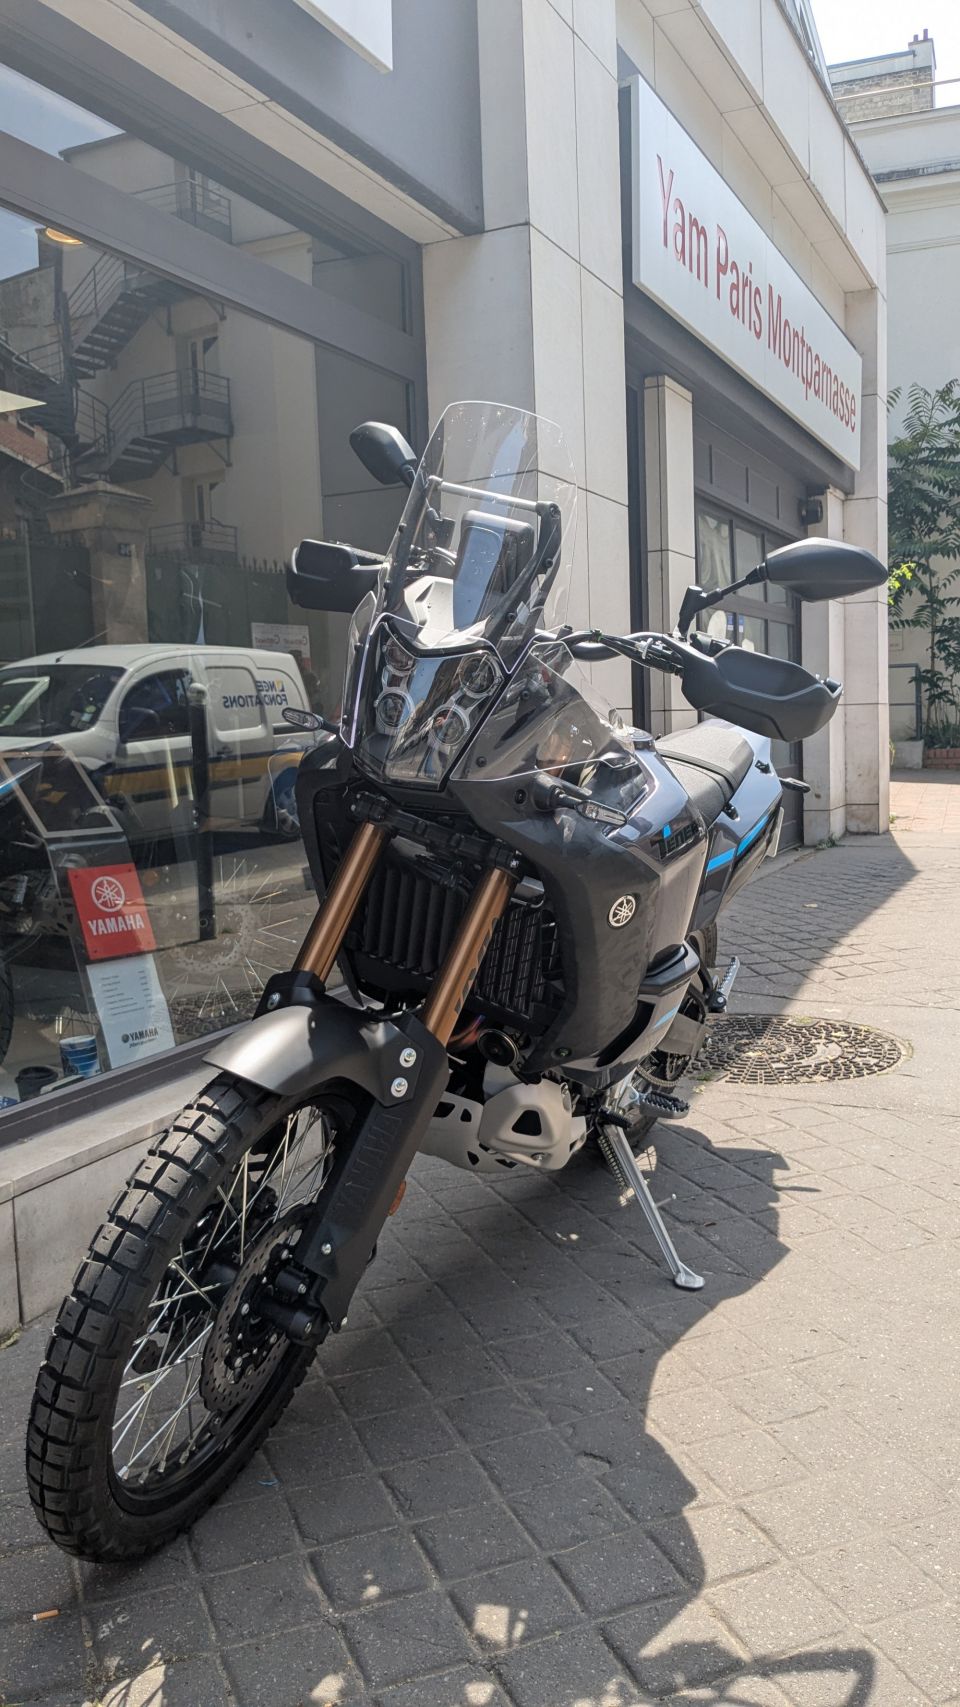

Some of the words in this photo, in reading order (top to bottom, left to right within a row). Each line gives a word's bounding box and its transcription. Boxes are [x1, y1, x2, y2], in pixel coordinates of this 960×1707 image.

[656, 153, 708, 288] Yam
[716, 223, 762, 340] Paris
[767, 283, 856, 432] Montparnasse
[88, 912, 145, 936] YAMAHA
[129, 1027, 159, 1041] YAMAHA
